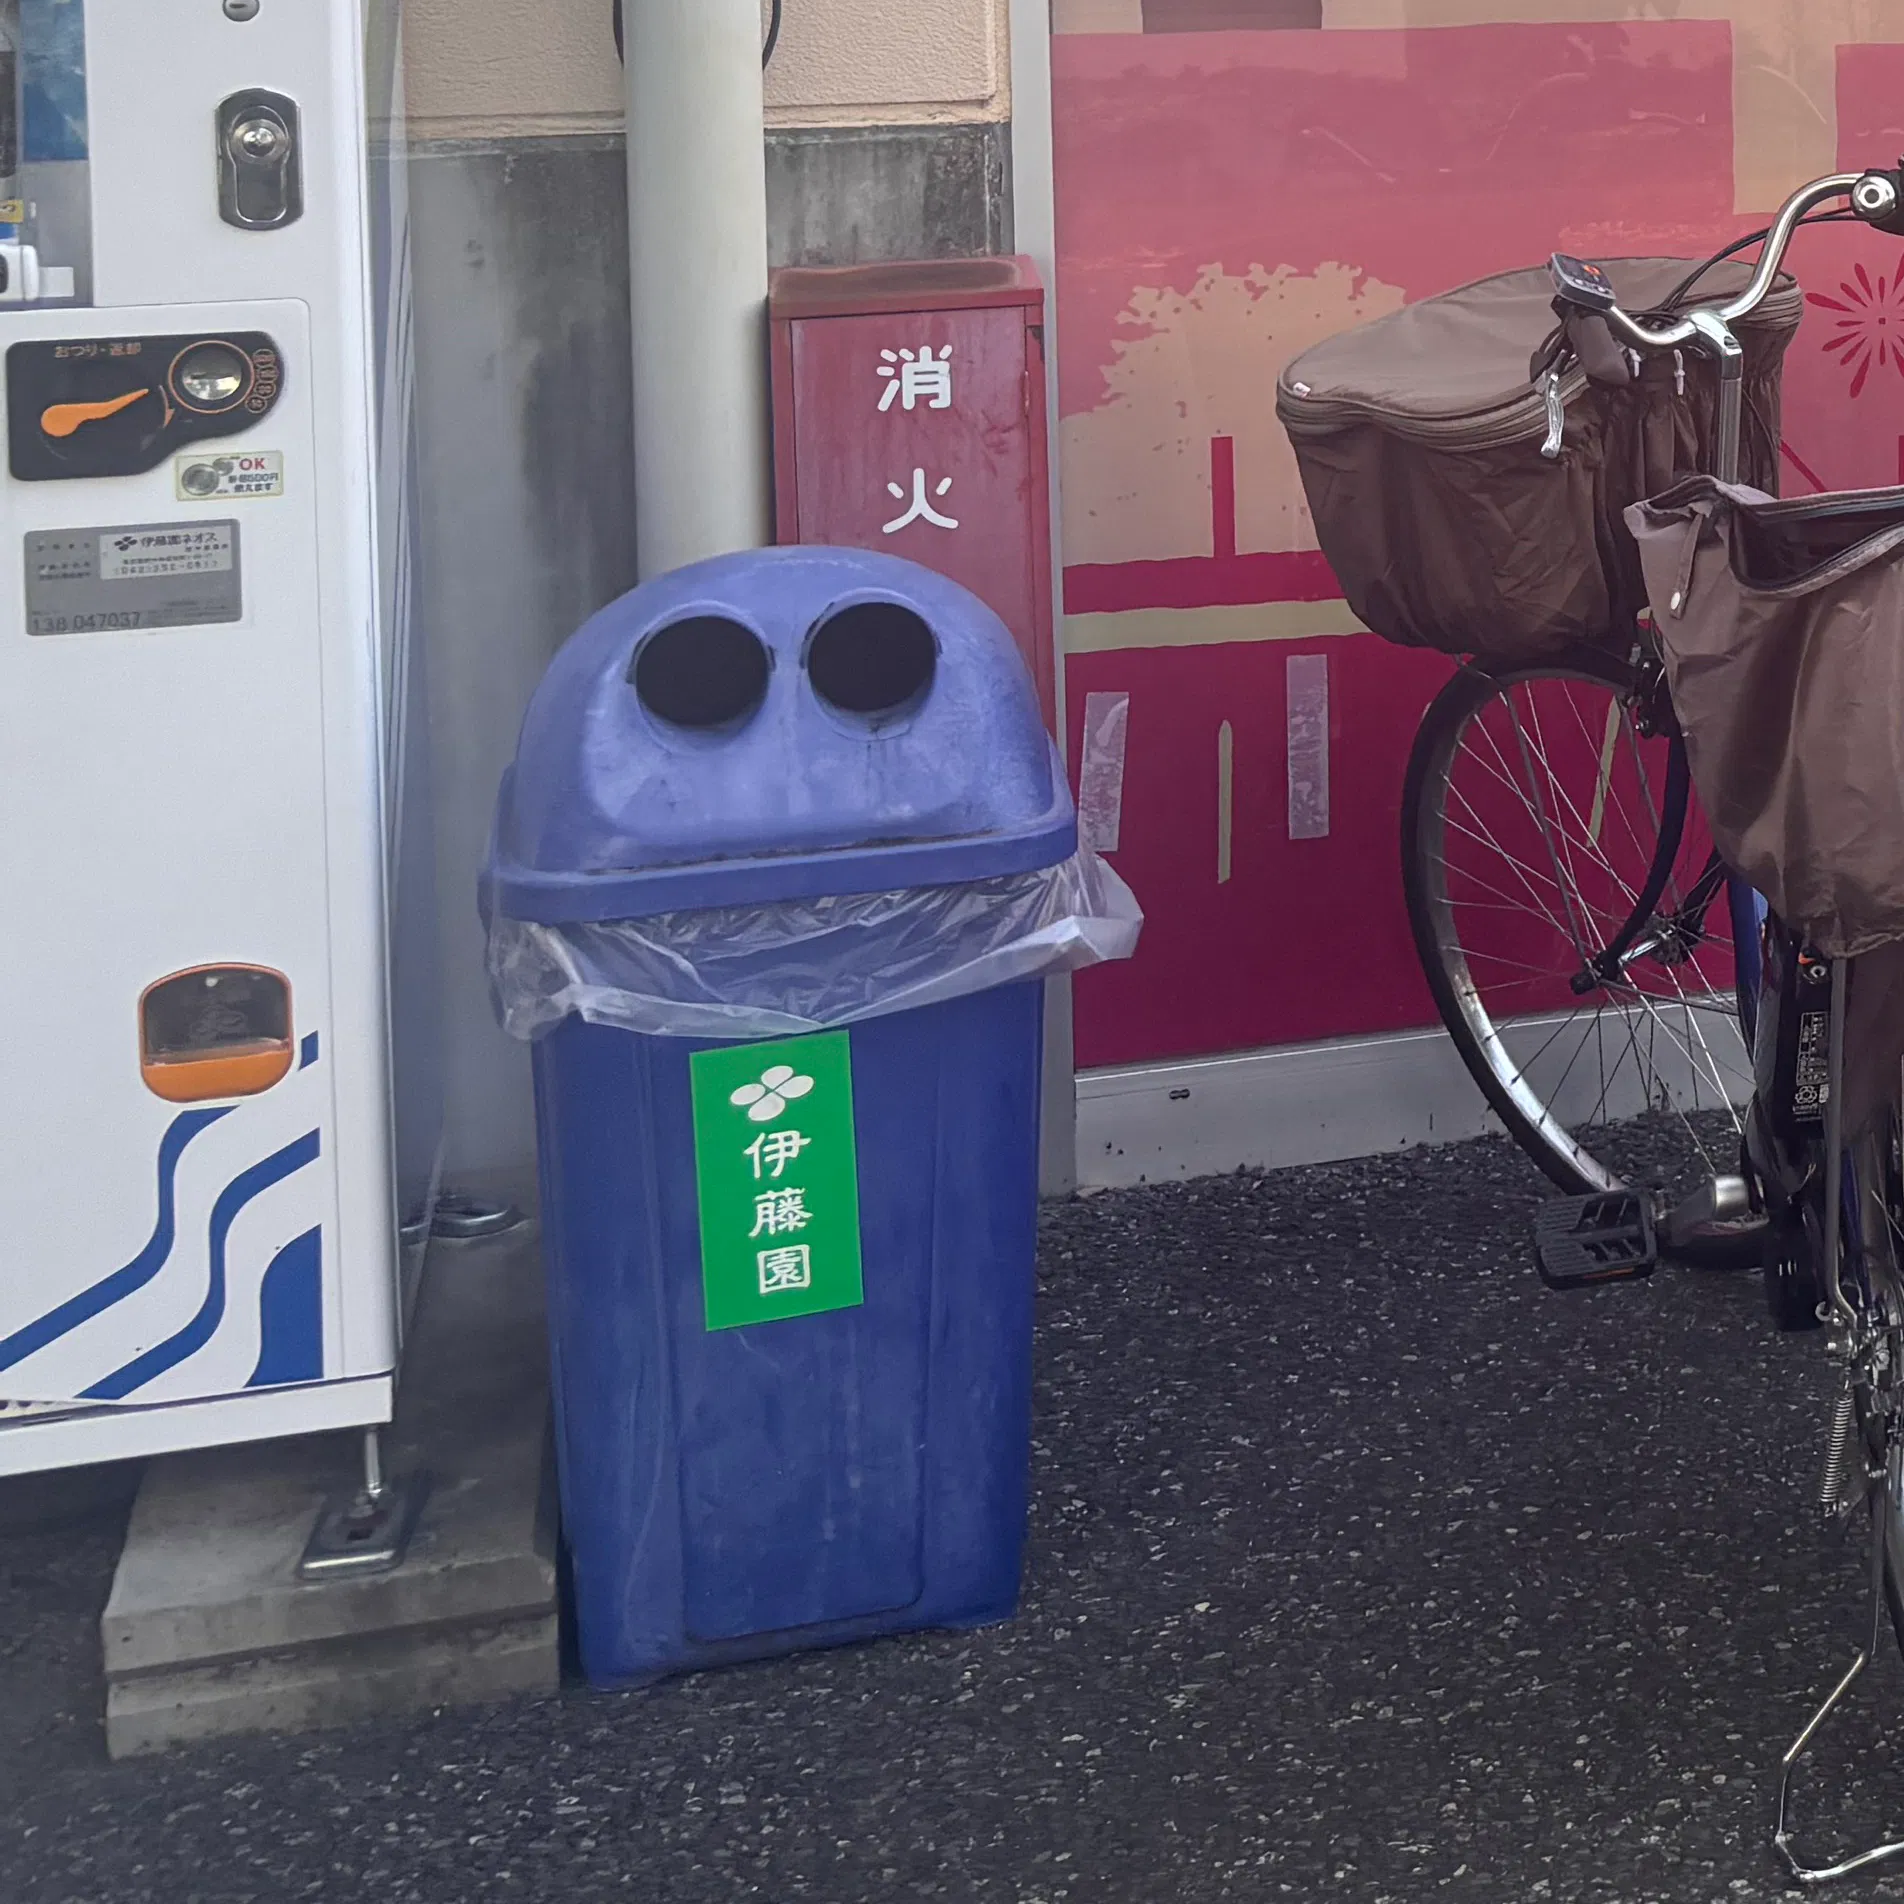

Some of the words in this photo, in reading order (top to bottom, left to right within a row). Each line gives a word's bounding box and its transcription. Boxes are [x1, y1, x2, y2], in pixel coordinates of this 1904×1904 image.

[239, 457, 266, 471] OK
[742, 1127, 814, 1294] 伊藤園
